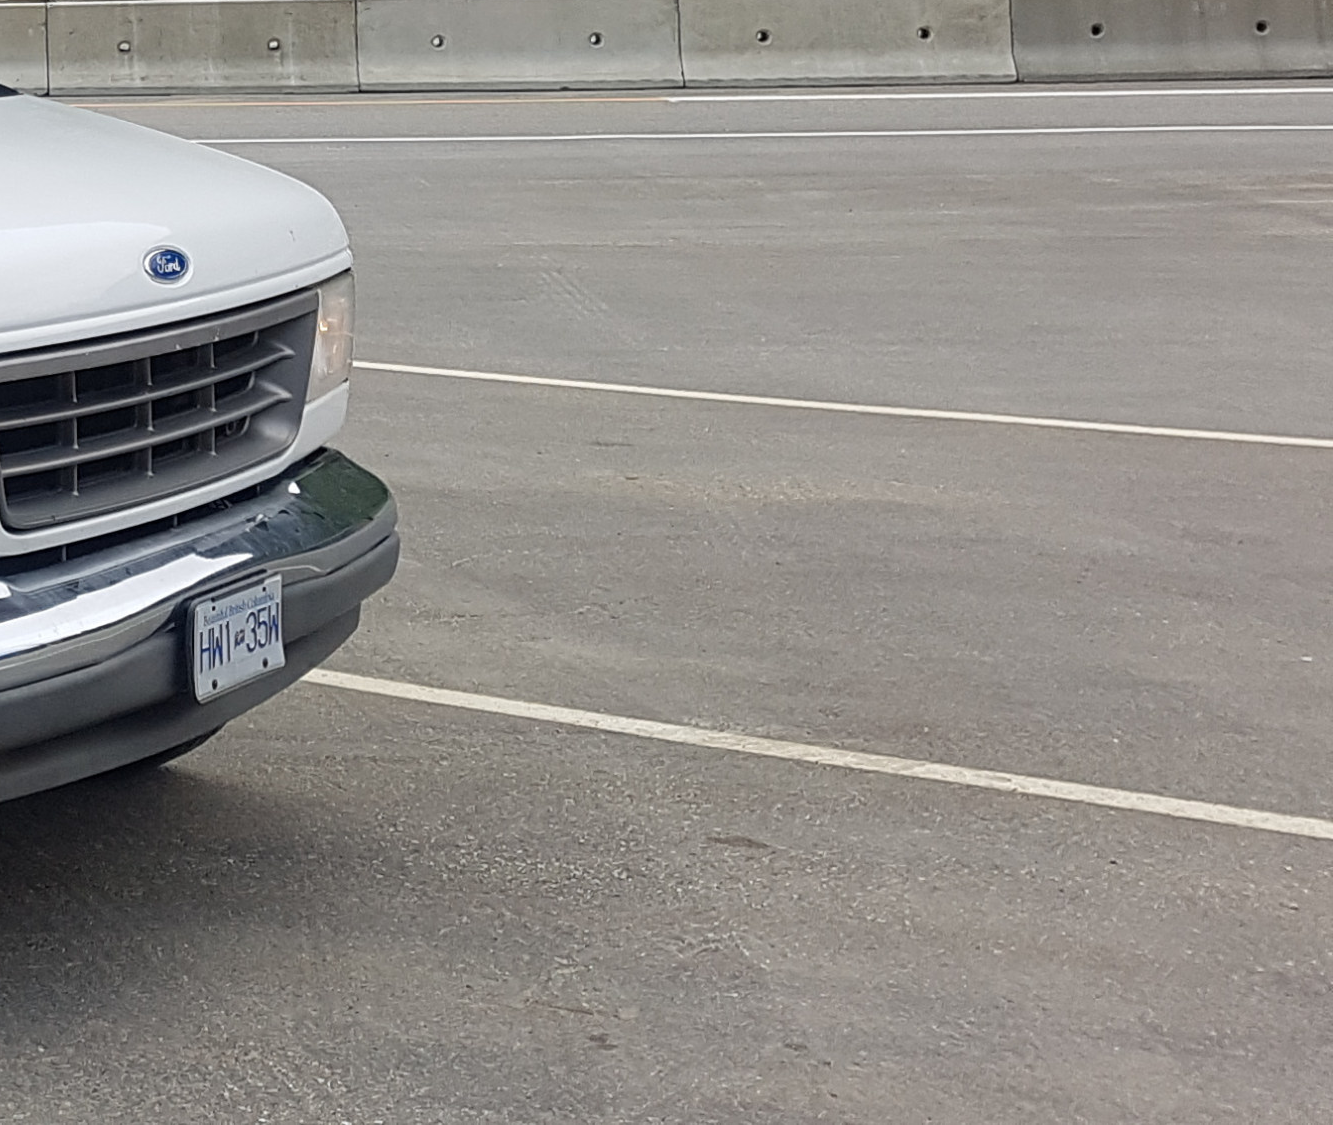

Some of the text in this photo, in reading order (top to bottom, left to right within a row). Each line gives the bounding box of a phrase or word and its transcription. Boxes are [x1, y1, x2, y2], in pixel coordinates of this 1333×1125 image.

[156, 253, 181, 274] Ford
[199, 602, 280, 674] HW1 35W
